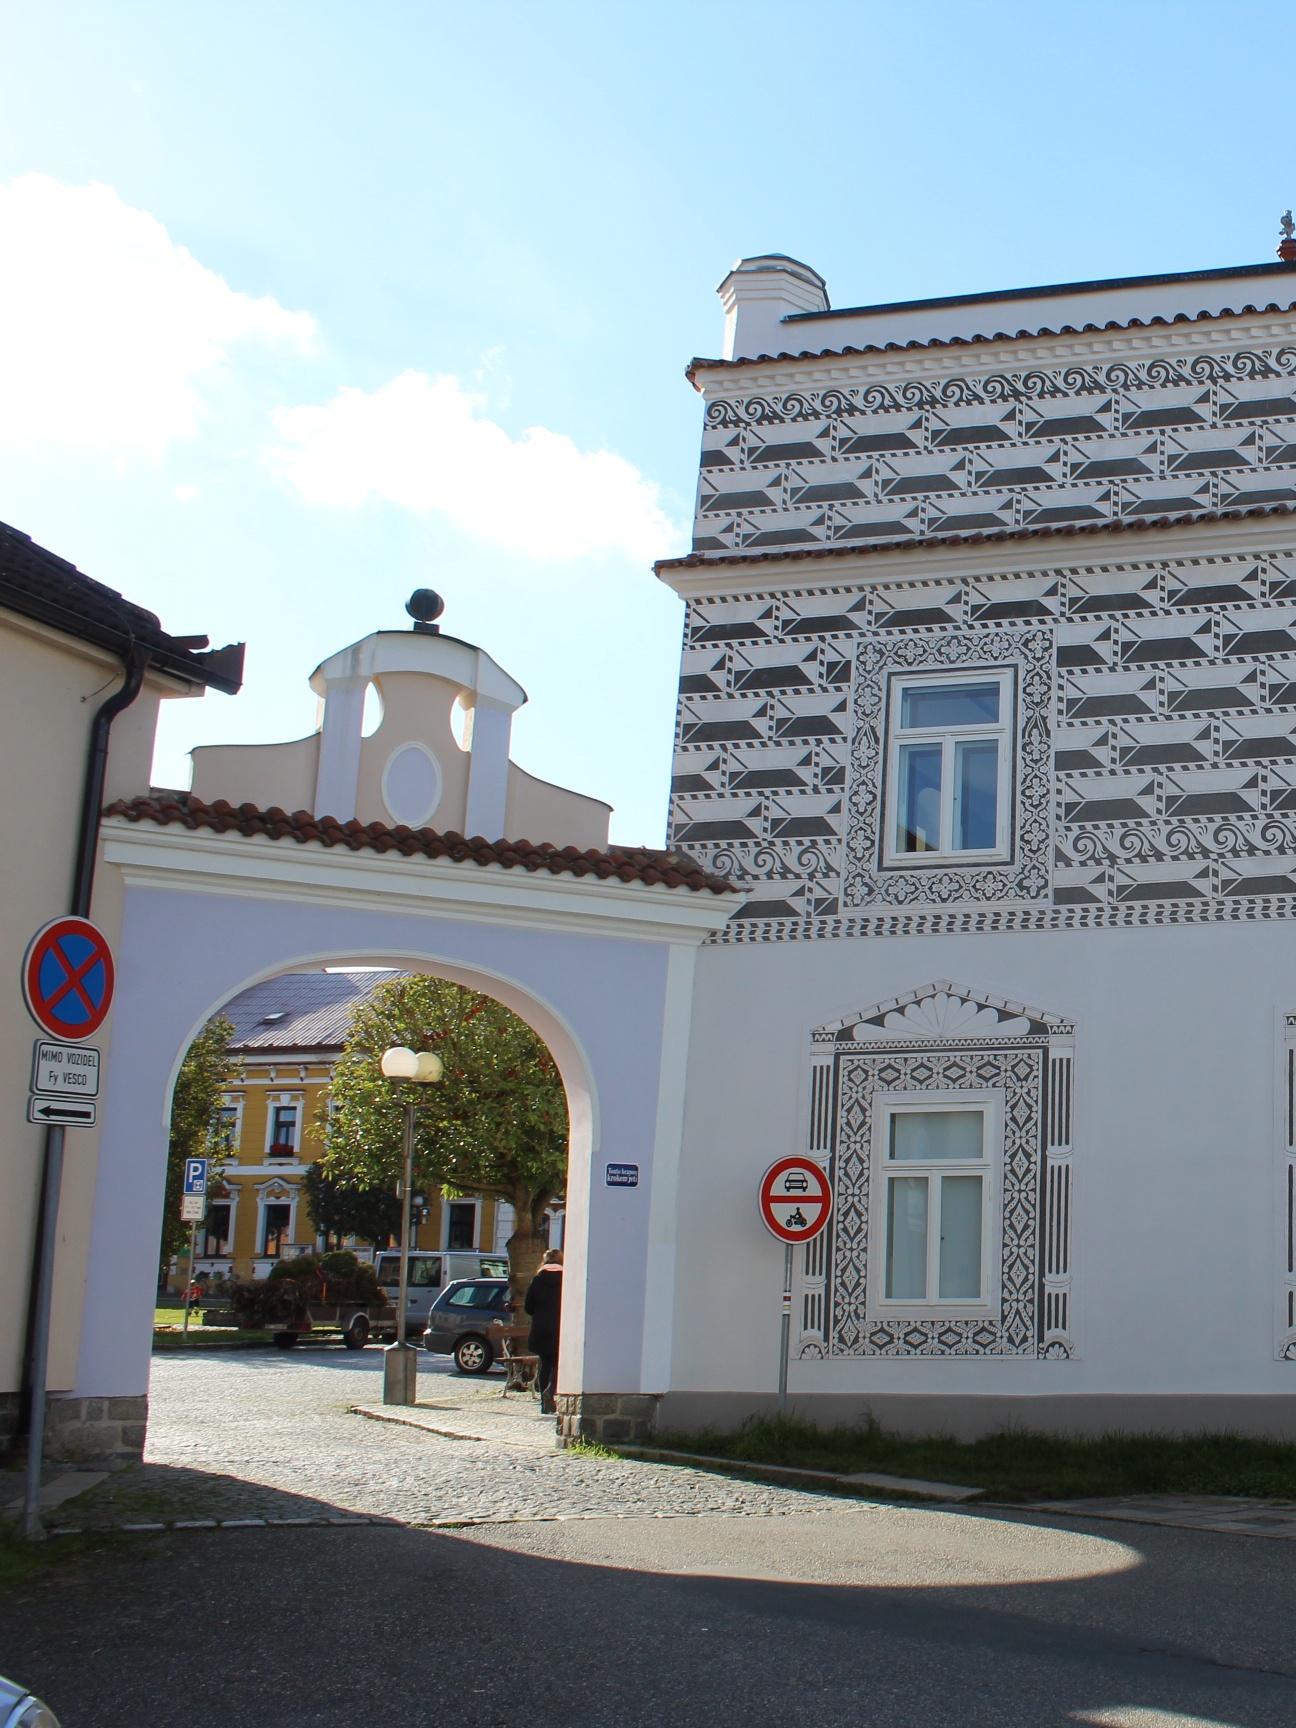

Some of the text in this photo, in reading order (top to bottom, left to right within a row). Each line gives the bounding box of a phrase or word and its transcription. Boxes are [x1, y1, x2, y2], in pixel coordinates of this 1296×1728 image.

[41, 1049, 97, 1067] MIMO VOZIDEL
[48, 1071, 87, 1086] Fy VESCO
[189, 1163, 202, 1183] P
